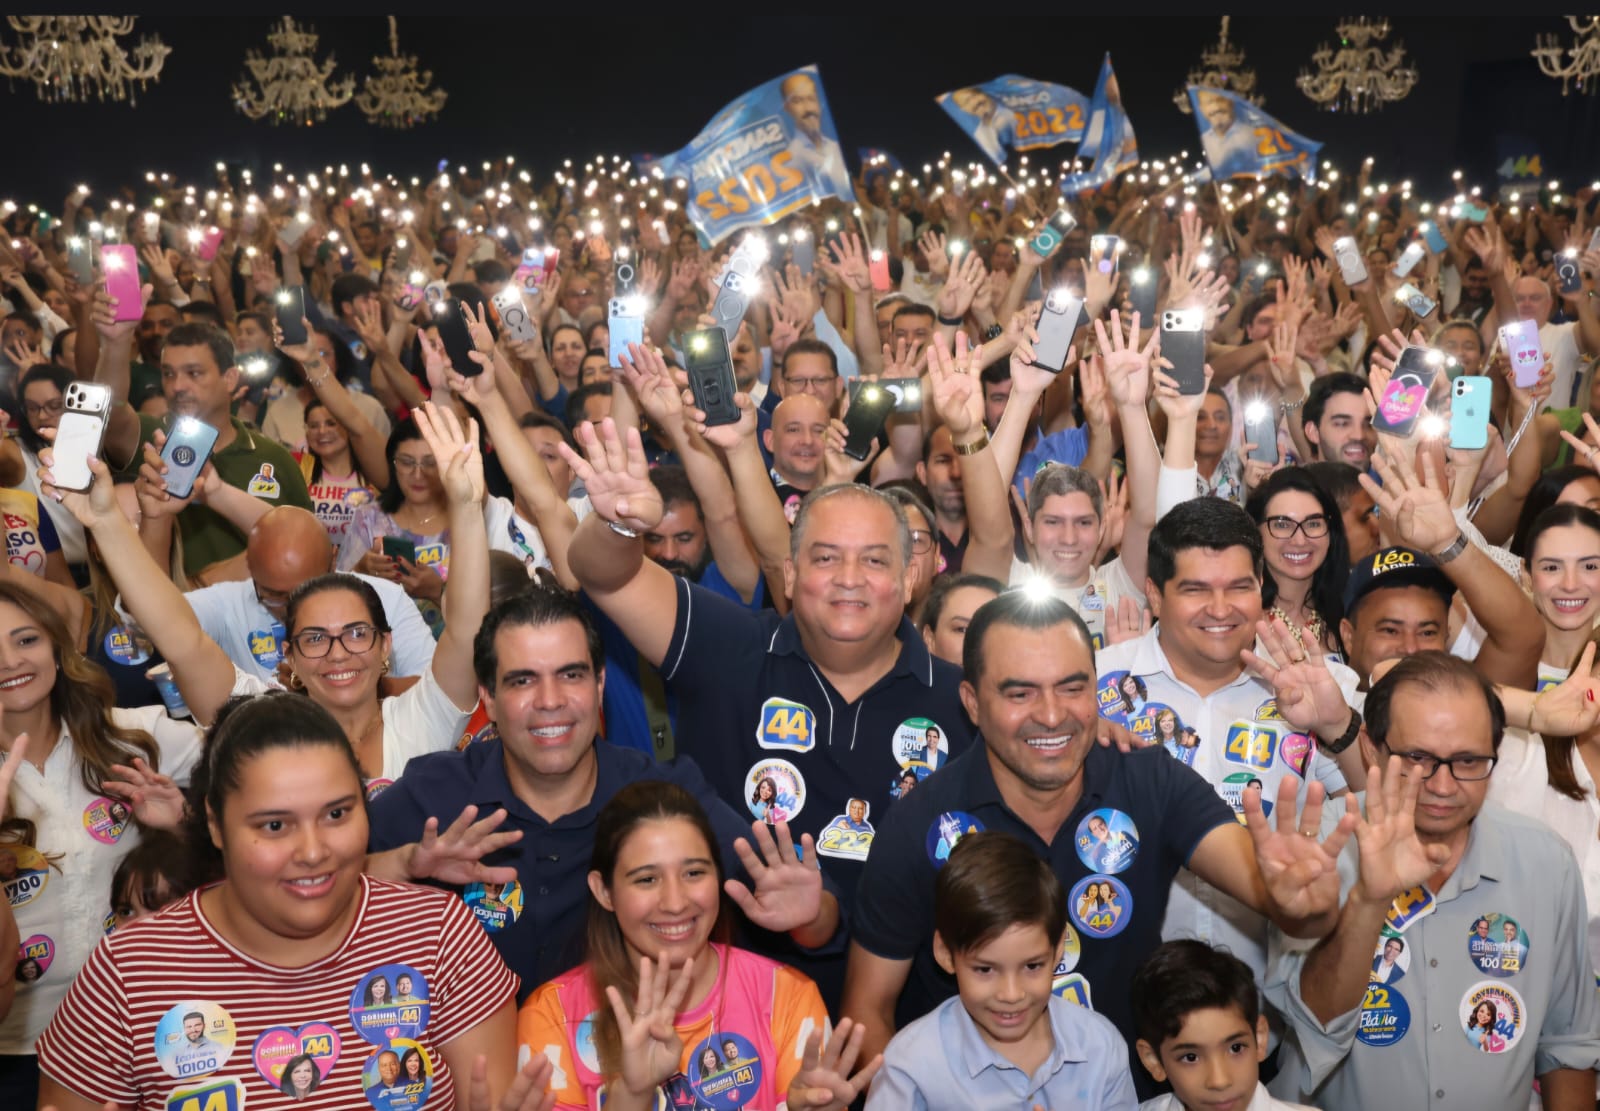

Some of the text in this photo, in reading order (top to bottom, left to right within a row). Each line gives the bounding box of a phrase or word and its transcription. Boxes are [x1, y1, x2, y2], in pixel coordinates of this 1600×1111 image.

[1014, 103, 1085, 139] 2022
[417, 548, 440, 564] 44
[1372, 550, 1415, 570] Léo
[1101, 687, 1118, 703] 44
[766, 708, 809, 741] 44
[1133, 717, 1153, 733] 44
[1229, 730, 1271, 763] 44
[1089, 913, 1113, 929] 44
[28, 943, 48, 957] 44
[1479, 956, 1519, 971] 100 22
[1363, 988, 1392, 1009] 22
[400, 1008, 419, 1023] 44
[1494, 1018, 1516, 1040] 44
[304, 1036, 331, 1056] 44
[177, 1057, 217, 1076] 10100
[737, 1069, 752, 1083] 44
